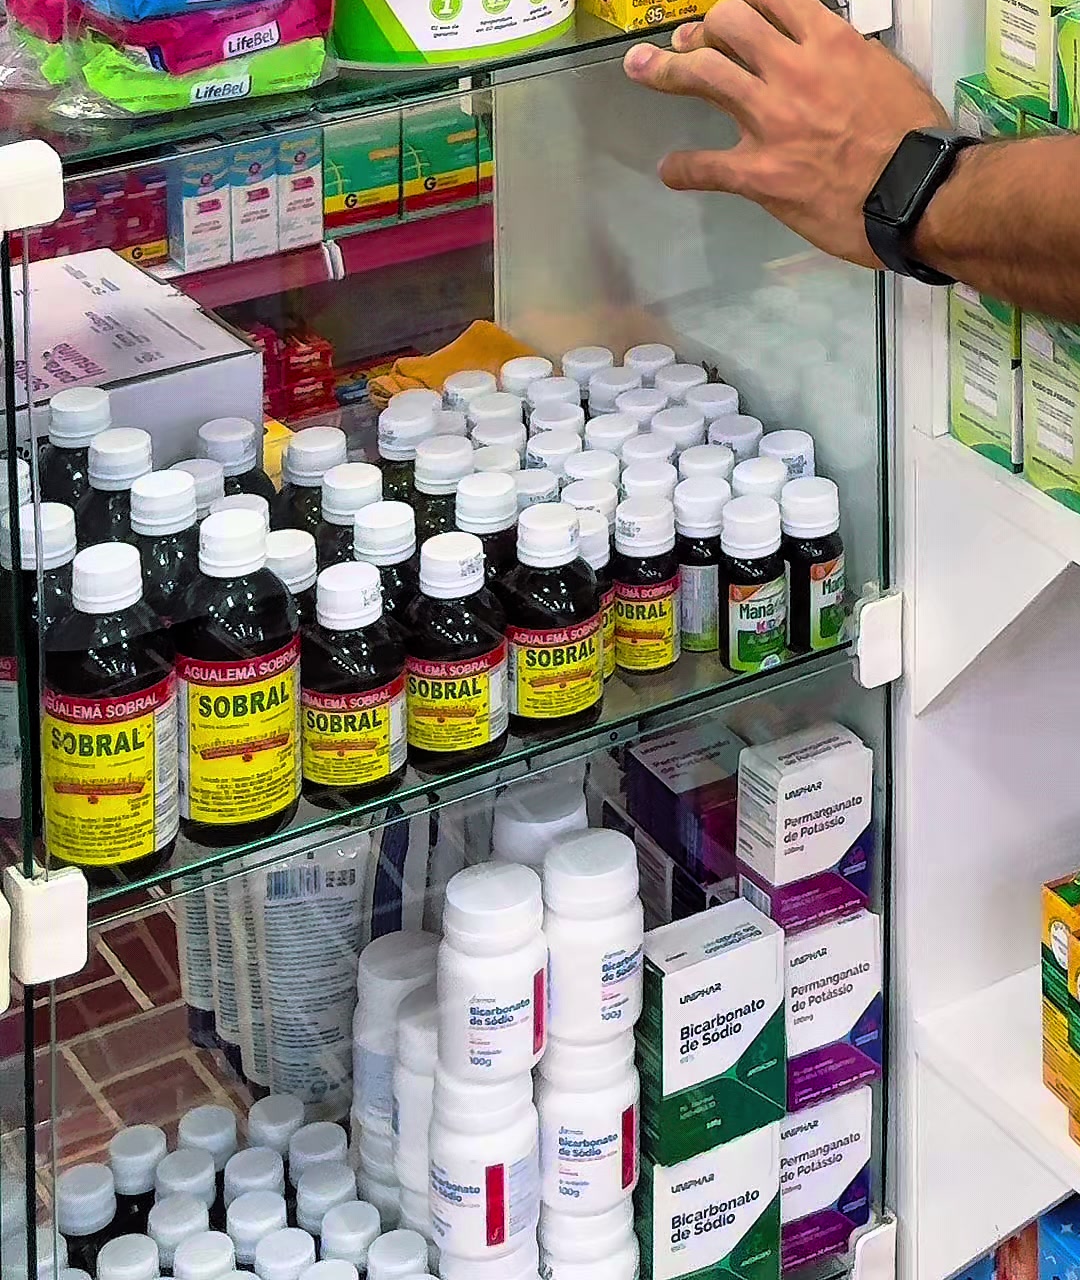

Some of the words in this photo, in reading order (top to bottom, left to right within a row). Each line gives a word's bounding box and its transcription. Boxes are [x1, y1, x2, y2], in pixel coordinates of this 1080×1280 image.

[227, 30, 274, 53] LifeBel
[195, 79, 245, 101] LifeBel
[184, 663, 256, 682] AGUALEMÃ
[259, 645, 298, 676] SOBRAL
[525, 643, 596, 668] SOBRAL
[448, 659, 490, 676] SOBRAL
[199, 681, 290, 719] SOBRAL
[349, 689, 391, 707] SOBRAL
[408, 677, 483, 700] SOBRAL
[105, 693, 158, 719] SOBRAL
[306, 710, 383, 733] SOBRAL
[51, 727, 145, 757] SOBRAL
[784, 781, 822, 800] UNIPHAR
[783, 794, 863, 830] Permanganato
[784, 829, 799, 844] de
[800, 814, 846, 837] Potássio
[789, 947, 828, 968] UNIPHAR
[790, 960, 870, 998] Permanganato
[679, 982, 722, 1006] UNIPHAR
[791, 999, 806, 1014] de
[807, 982, 854, 1006] Potássio
[469, 998, 530, 1017] Bicarbonato
[469, 1017, 482, 1026] de
[484, 1013, 514, 1026] Sódio
[680, 998, 766, 1041] Bicarbonato
[680, 1040, 700, 1056] de
[702, 1021, 742, 1047] Sódio
[469, 1056, 492, 1067] 100g
[558, 1133, 619, 1147] Bicarbonato
[780, 1120, 819, 1140] UNIPHAR
[558, 1147, 571, 1156] de
[572, 1145, 602, 1157] Sódio
[780, 1131, 861, 1170] Permanganato
[796, 1152, 844, 1177] Potássio
[558, 1186, 580, 1198] 100g
[671, 1173, 715, 1194] UNIPHAR
[671, 1188, 760, 1230] Bicarbonato
[671, 1230, 690, 1244] de
[694, 1212, 736, 1234] Sódio
